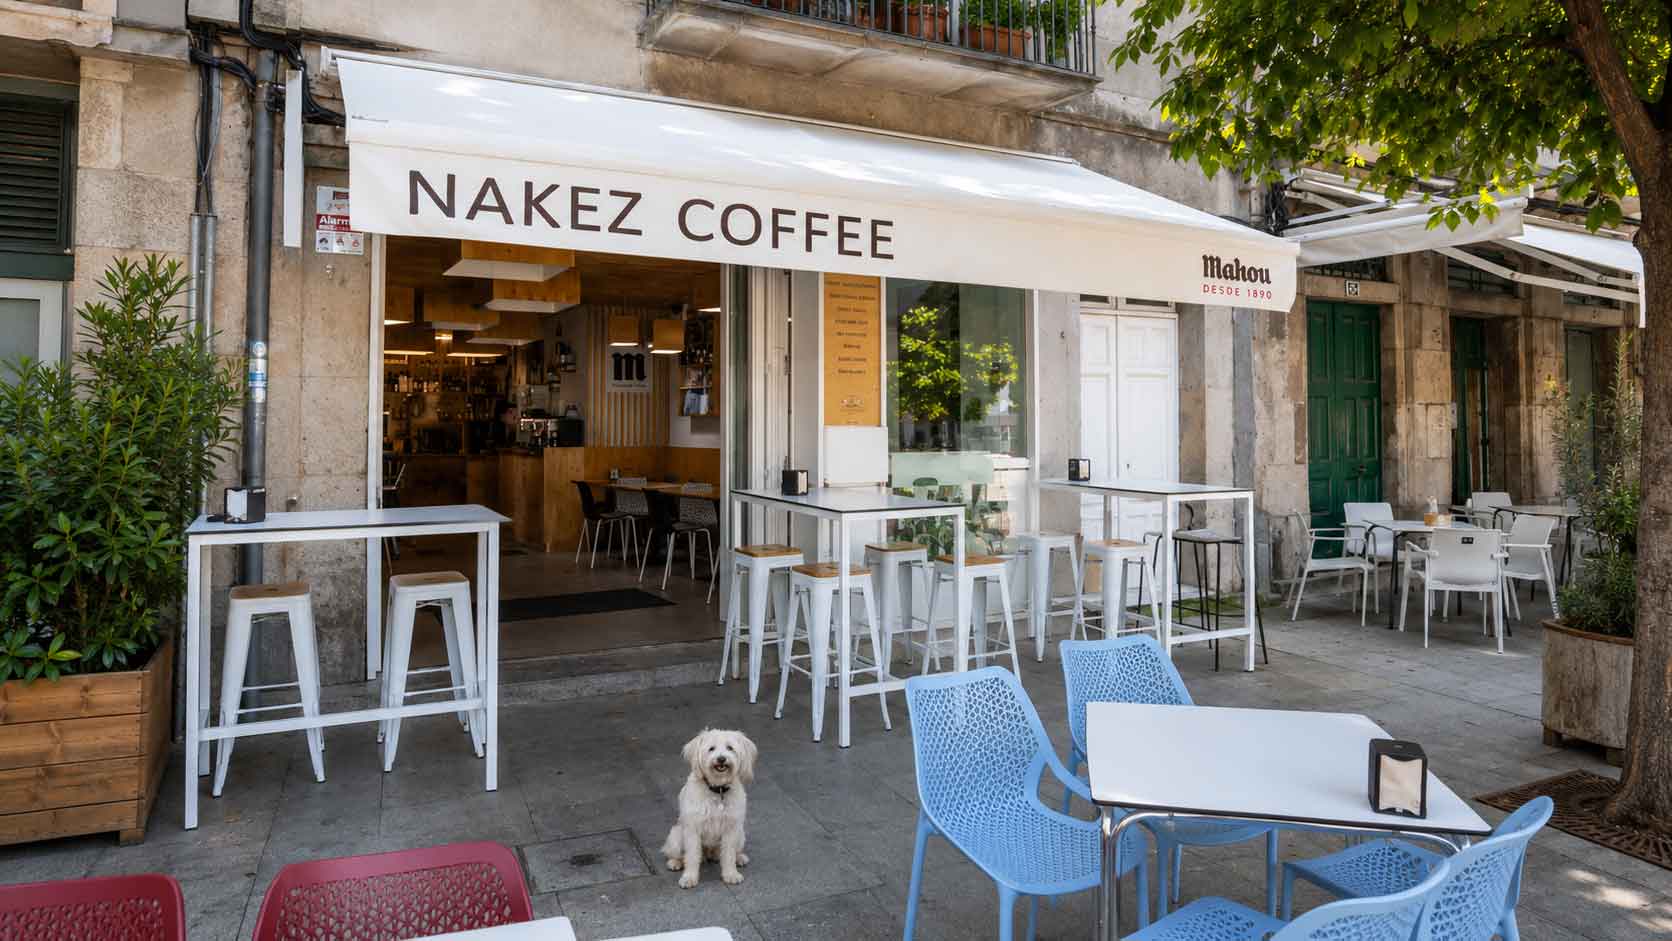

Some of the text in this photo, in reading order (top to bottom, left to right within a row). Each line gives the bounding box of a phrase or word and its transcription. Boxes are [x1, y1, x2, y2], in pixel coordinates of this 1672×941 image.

[408, 169, 895, 261] NAKEZ COFFEE
[1202, 254, 1272, 284] Mahou
[1203, 284, 1273, 300] DESDE 1890
